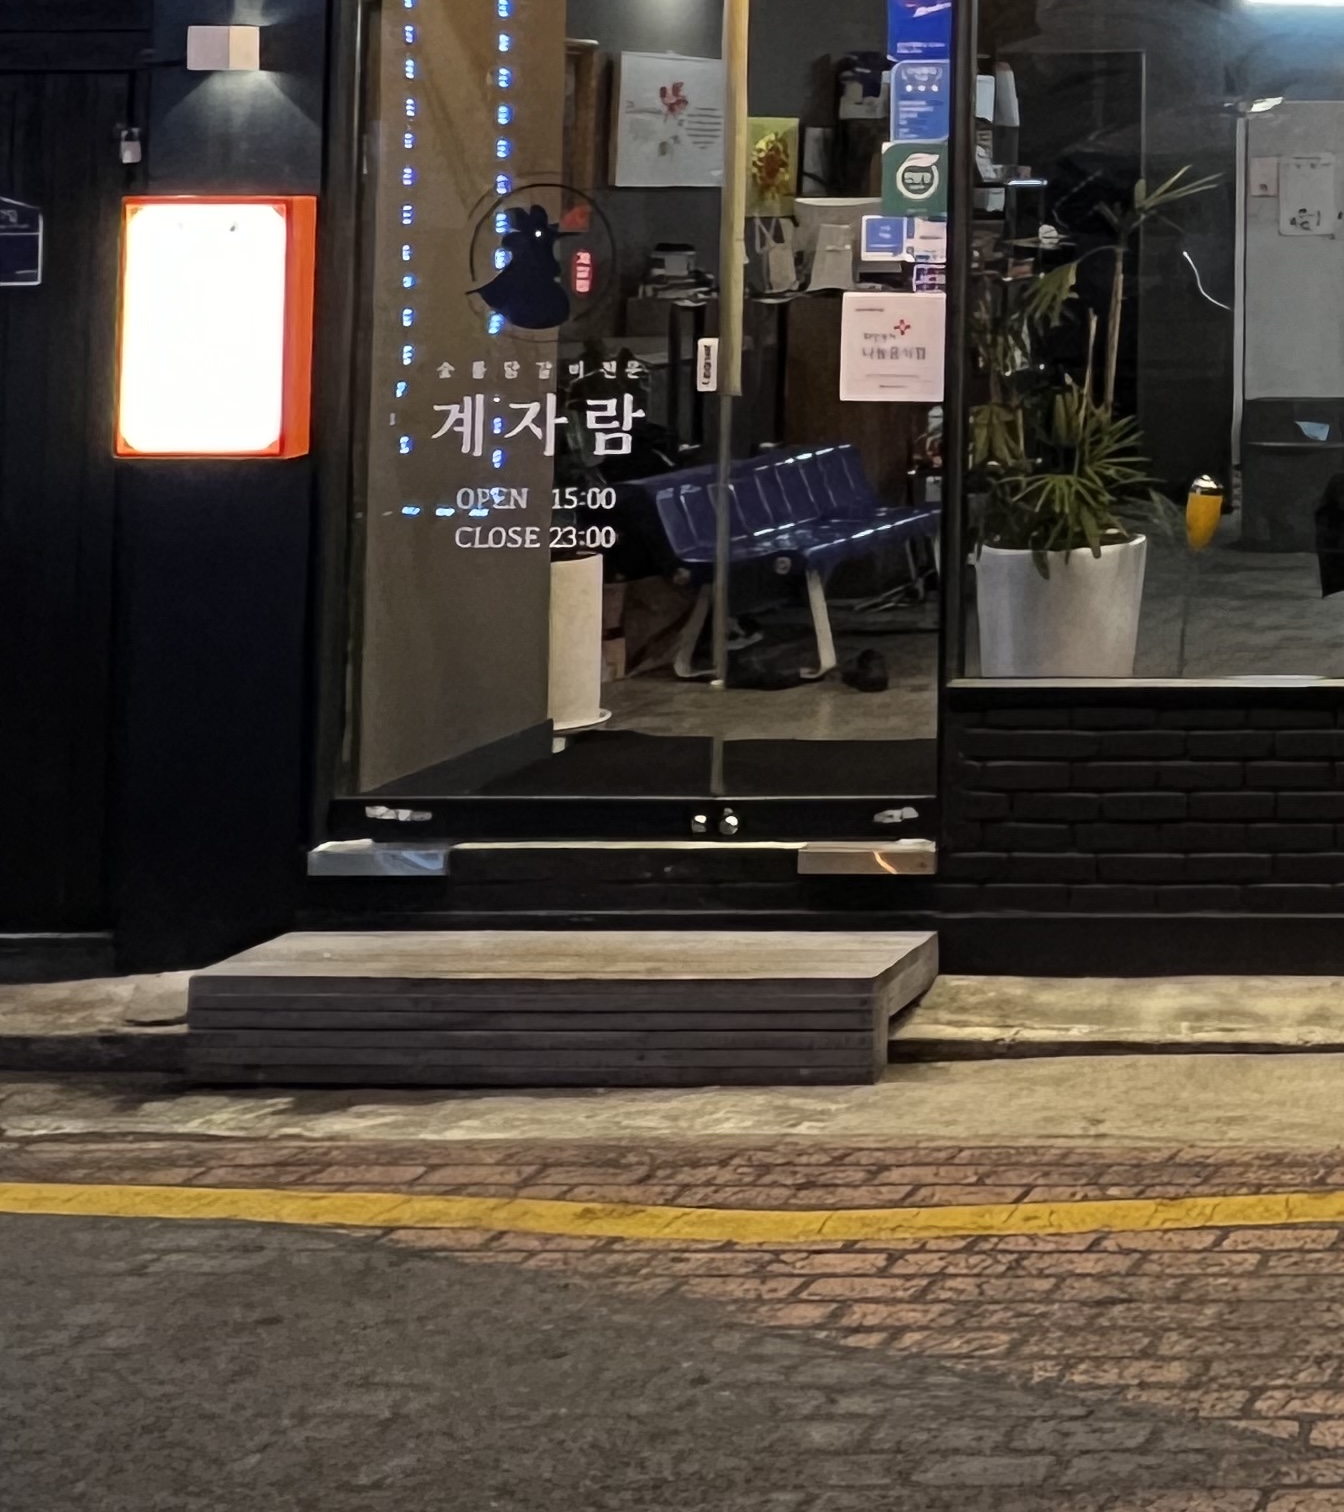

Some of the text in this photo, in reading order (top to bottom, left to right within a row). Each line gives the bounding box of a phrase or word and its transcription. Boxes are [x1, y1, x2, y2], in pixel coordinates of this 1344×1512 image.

[431, 392, 646, 457] 계자람
[456, 487, 616, 510] OPEN 15:00
[455, 526, 617, 549] CLOSE 23:00
